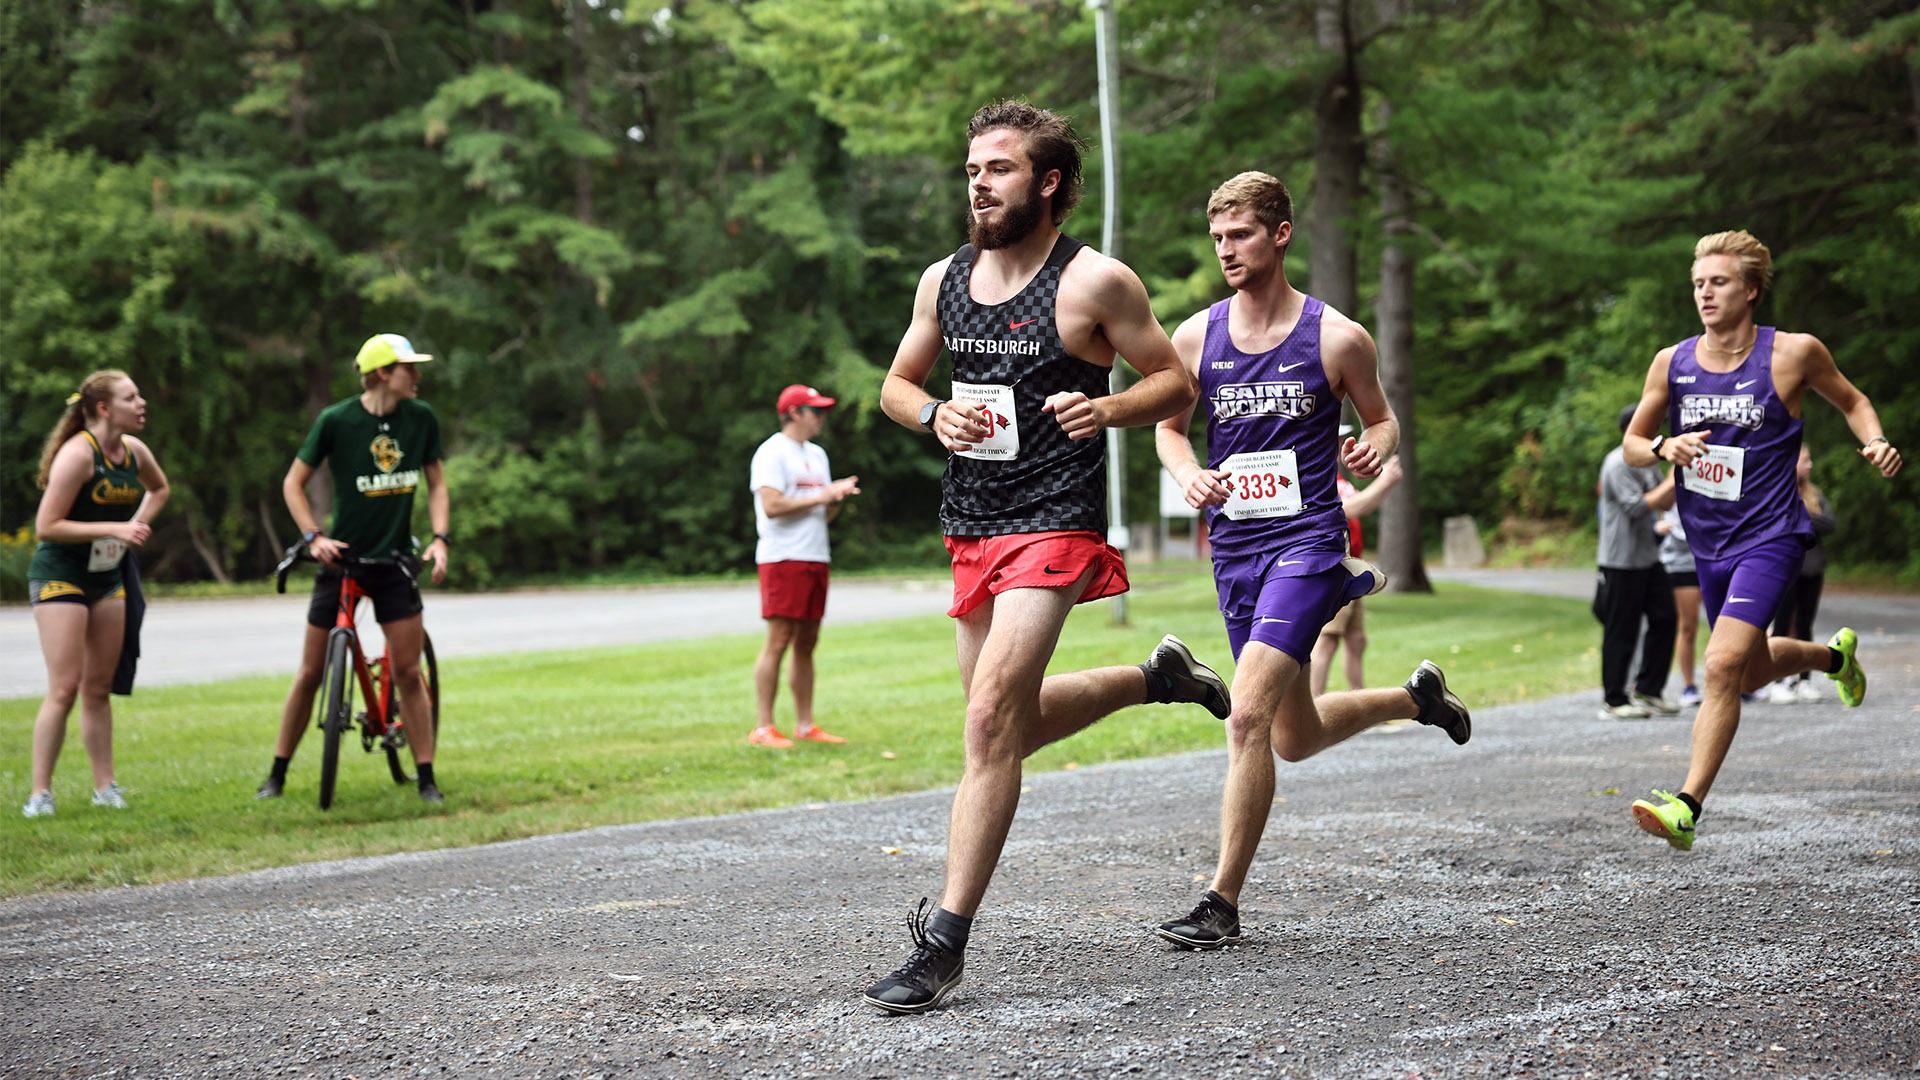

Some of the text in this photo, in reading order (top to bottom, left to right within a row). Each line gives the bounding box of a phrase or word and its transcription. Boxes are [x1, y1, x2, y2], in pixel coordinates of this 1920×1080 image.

[1219, 384, 1300, 401] SAINT
[1683, 397, 1752, 409] SAINT
[1213, 398, 1313, 420] MICHAEL'S
[1696, 460, 1723, 483] 320
[1238, 472, 1277, 501] 333
